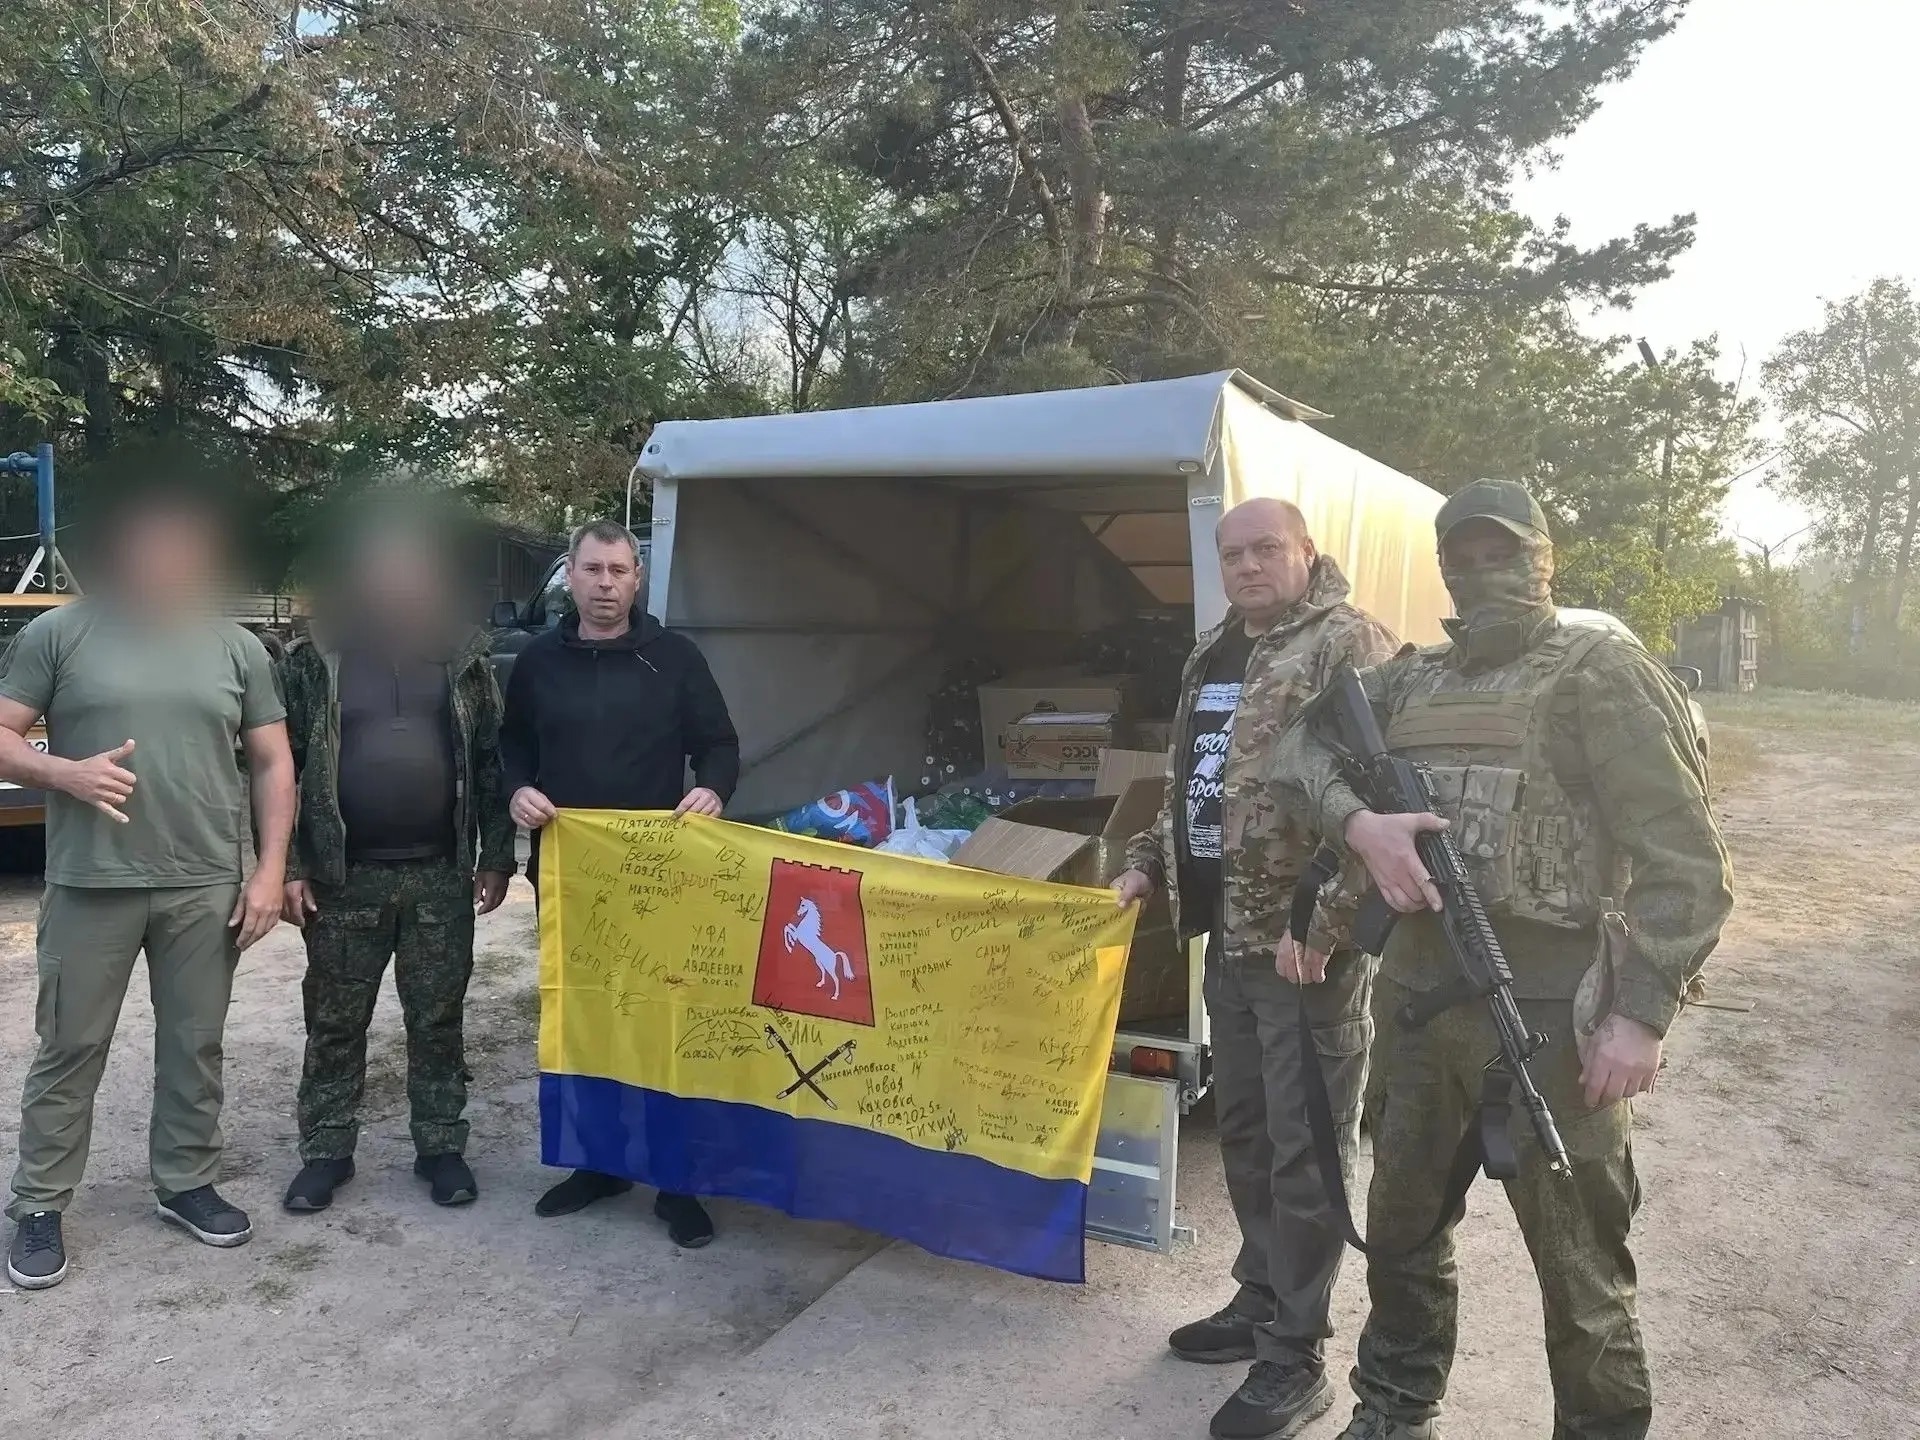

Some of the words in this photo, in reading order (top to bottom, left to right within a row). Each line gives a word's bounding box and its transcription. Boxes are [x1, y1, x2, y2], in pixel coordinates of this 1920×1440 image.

[692, 924, 727, 947] УФА
[690, 943, 725, 960] МУХА
[683, 957, 745, 977] АВДЕЕВКА
[865, 1075, 904, 1096] Новая
[906, 1108, 958, 1139] ТИХИЙ
